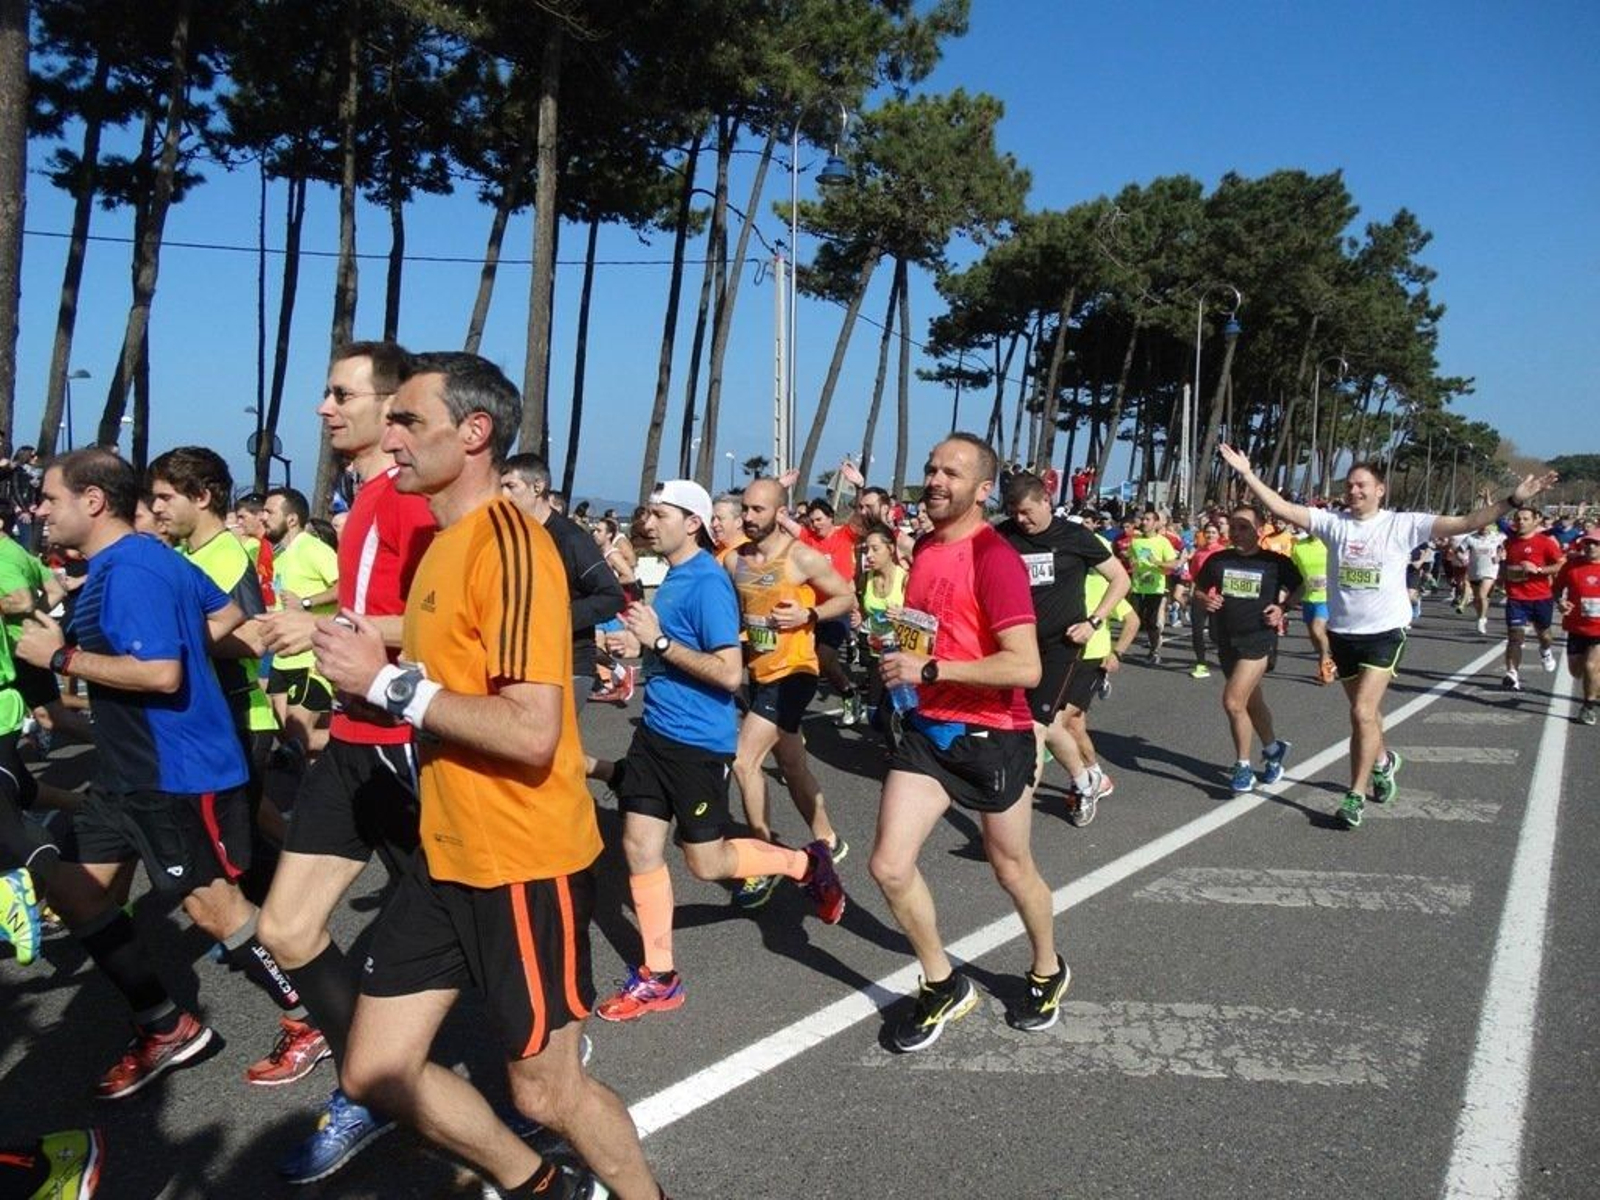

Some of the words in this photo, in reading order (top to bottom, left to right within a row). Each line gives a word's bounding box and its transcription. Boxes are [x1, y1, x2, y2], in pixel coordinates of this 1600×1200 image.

[1026, 564, 1046, 578] 04
[1346, 570, 1371, 583] 1399
[1231, 580, 1252, 592] 1580
